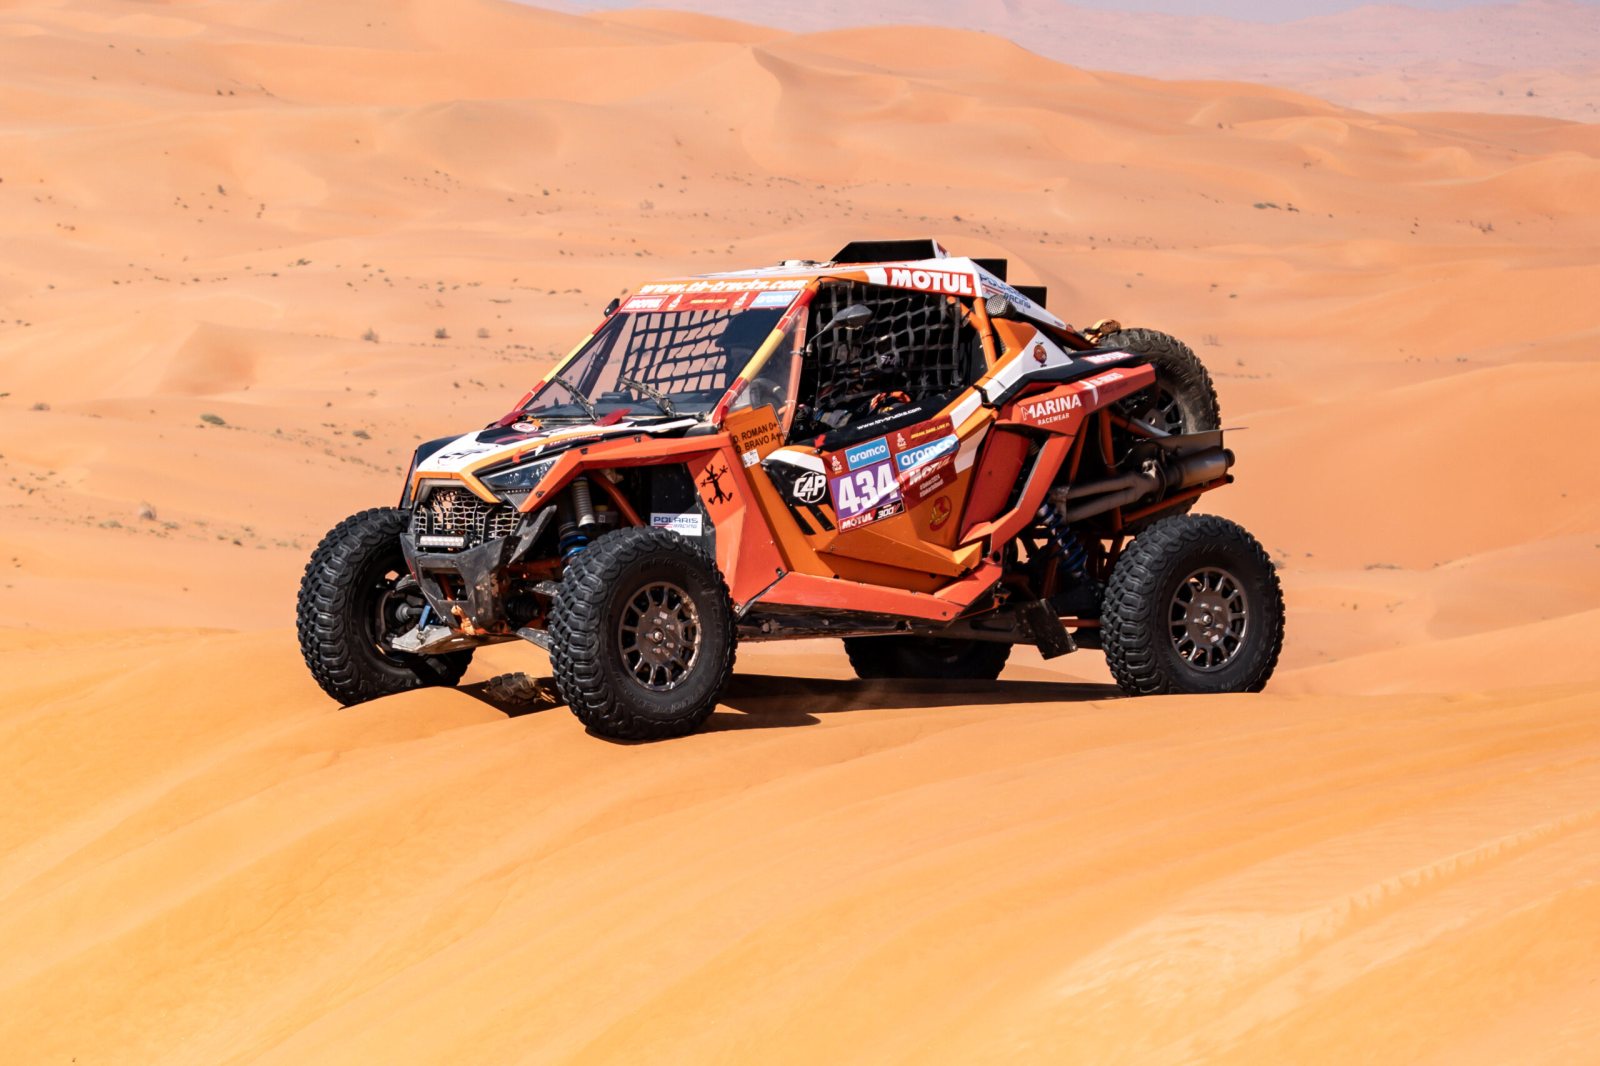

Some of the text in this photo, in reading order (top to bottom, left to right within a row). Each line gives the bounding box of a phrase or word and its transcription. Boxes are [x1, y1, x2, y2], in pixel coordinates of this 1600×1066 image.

[891, 268, 973, 294] MOTUL
[1021, 394, 1082, 421] MARINA
[1037, 412, 1070, 426] RACEWEAR
[741, 424, 769, 441] ROMAN
[744, 435, 770, 451] BRAVO
[901, 436, 955, 466] aramco
[849, 444, 886, 463] aramco
[838, 462, 900, 514] 434
[653, 516, 699, 524] POLARIS
[842, 513, 874, 529] MOTUL
